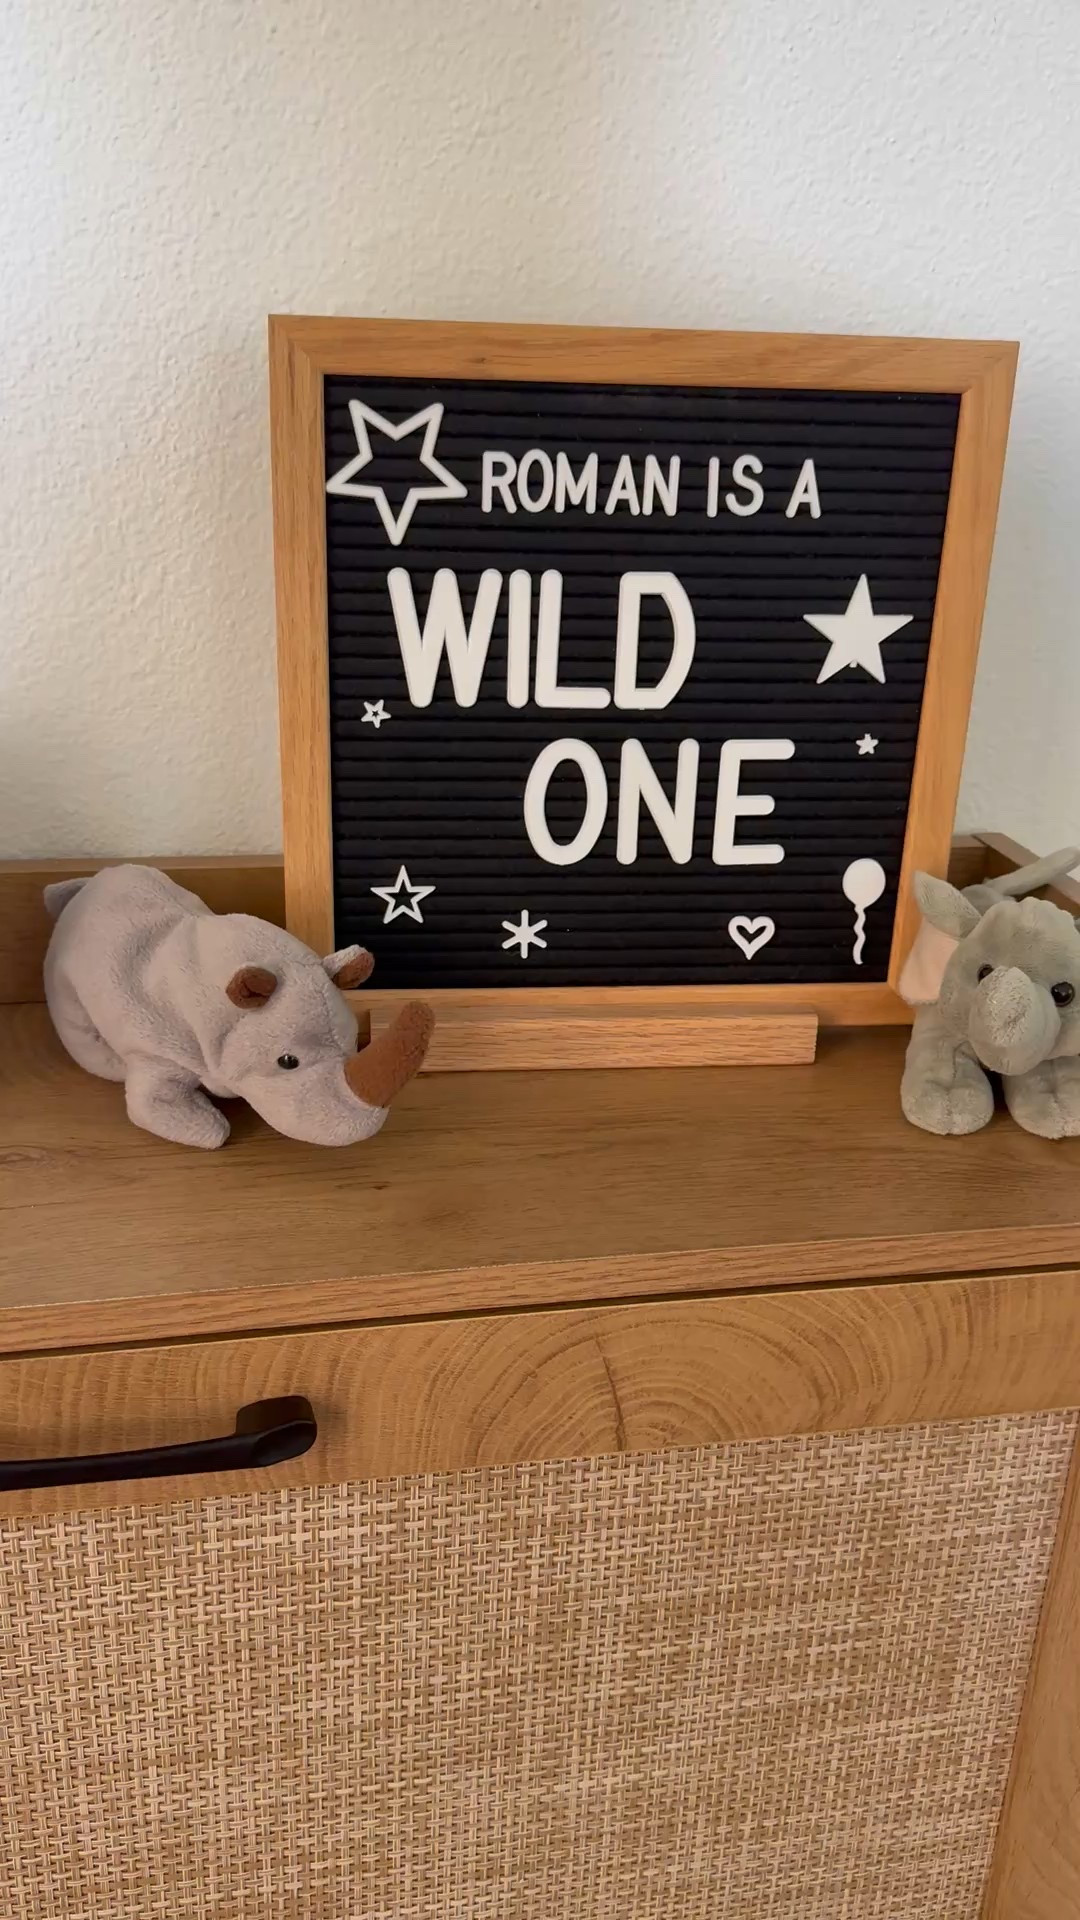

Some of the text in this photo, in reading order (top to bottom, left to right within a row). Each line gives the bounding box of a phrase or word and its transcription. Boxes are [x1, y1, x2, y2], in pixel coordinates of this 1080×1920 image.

[481, 448, 821, 519] ROMAN IS A
[387, 567, 696, 711] WILD
[523, 738, 796, 866] ONE
